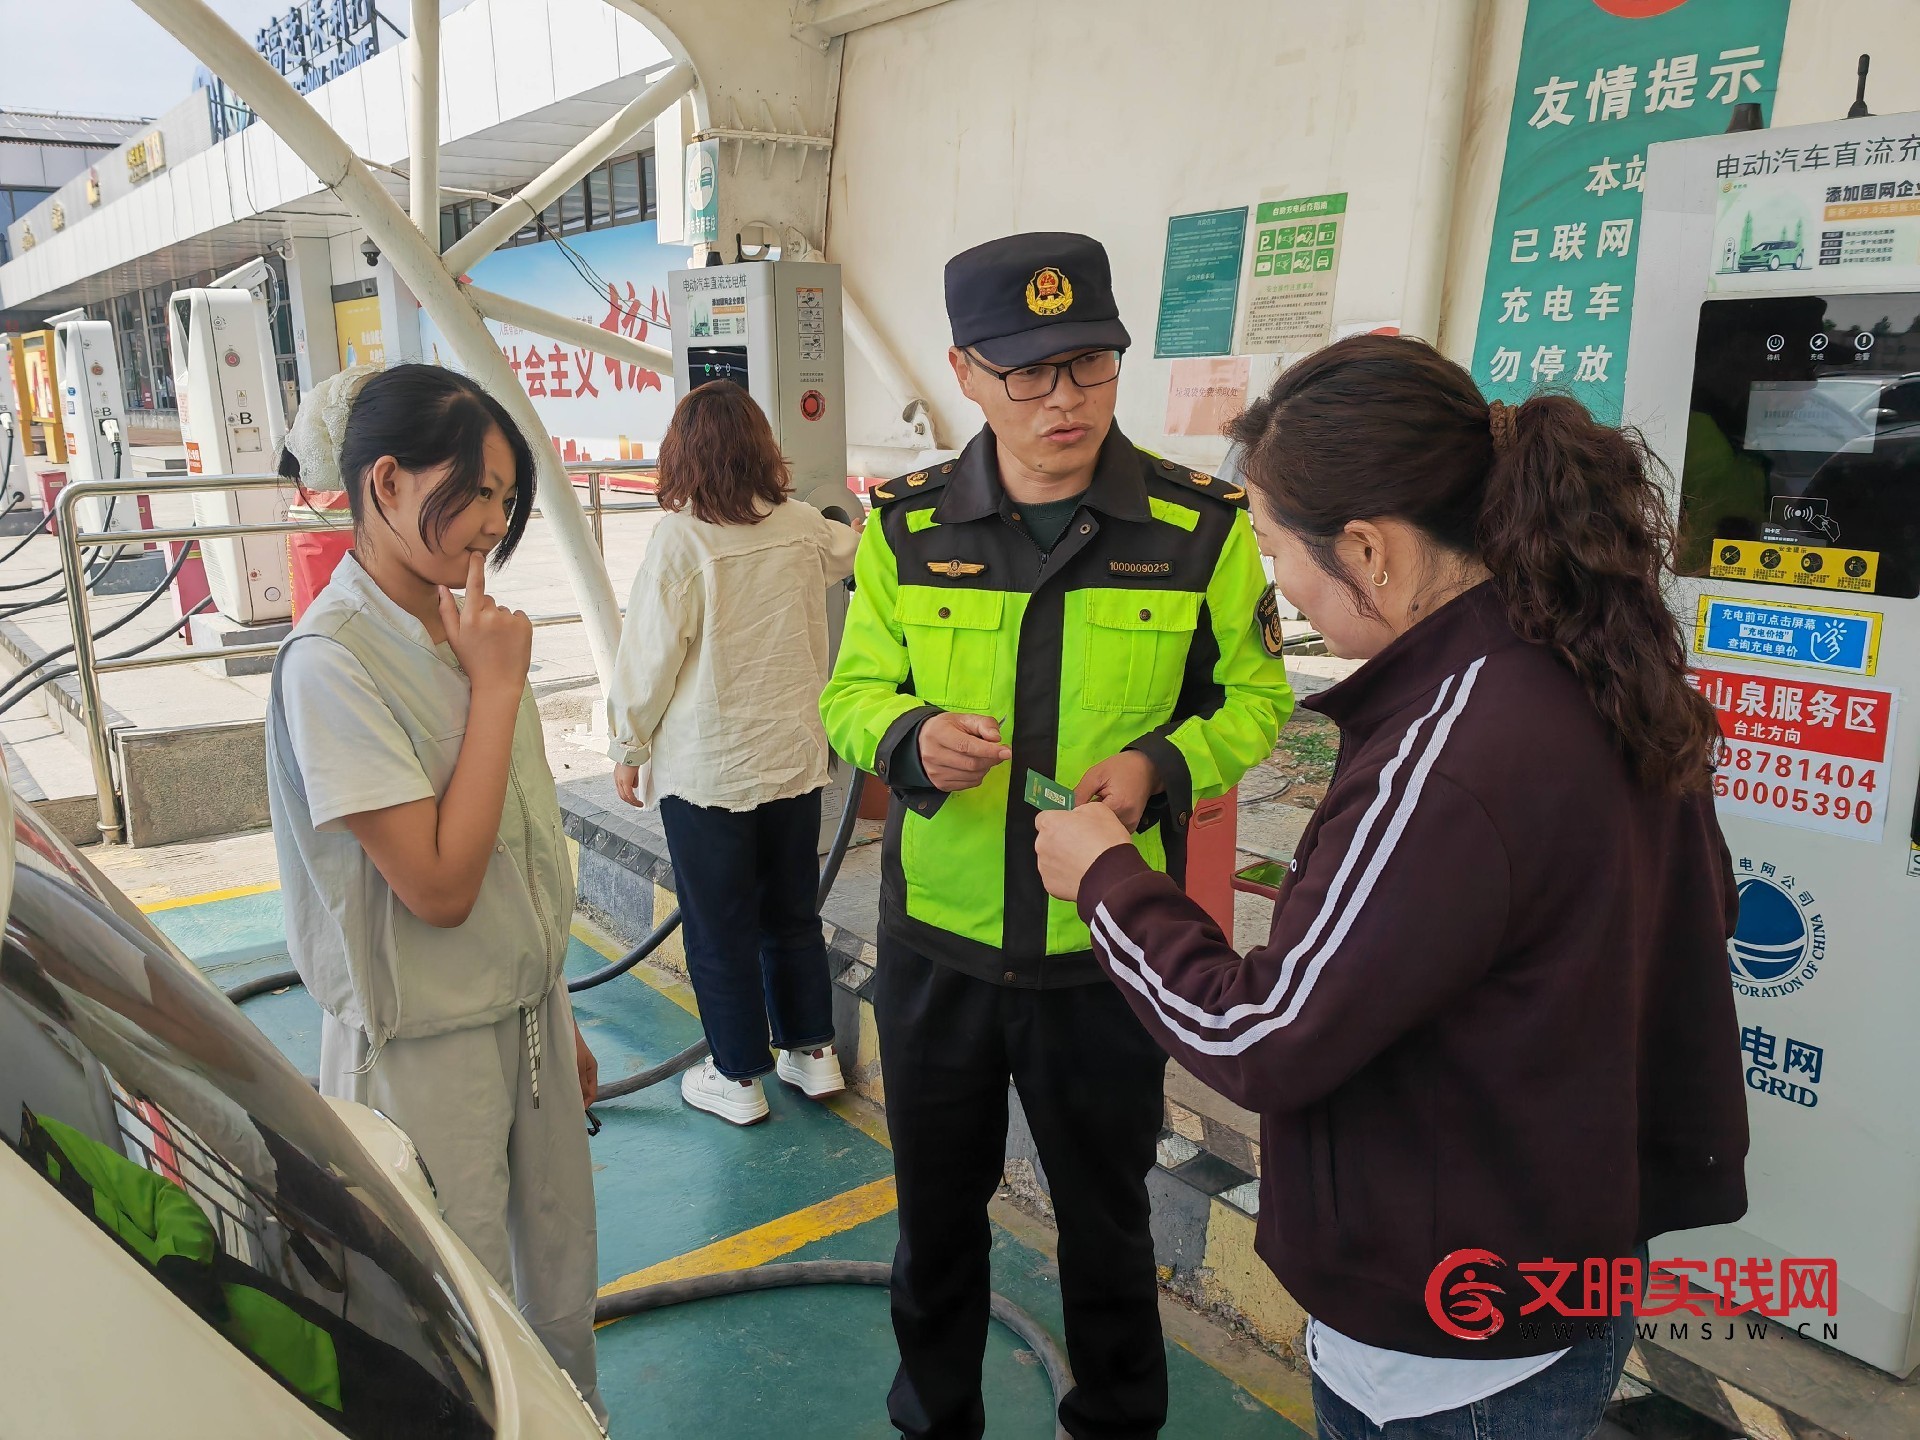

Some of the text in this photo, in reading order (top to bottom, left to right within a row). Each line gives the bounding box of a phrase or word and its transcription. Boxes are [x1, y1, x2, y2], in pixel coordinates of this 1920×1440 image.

[1527, 45, 1765, 129] 友情提示
[1825, 180, 1920, 202] 添加国网企
[1272, 201, 1328, 216] 自助充电操作指南
[1510, 219, 1634, 263] 已联网
[683, 275, 747, 292] 电动汽车直流充电桩
[1498, 282, 1623, 323] 充电车
[1490, 344, 1613, 383] 勿停放
[1766, 352, 1871, 361] 待机 充电 告警
[1175, 387, 1238, 398] 垃圾袋免费领取处
[102, 407, 112, 416] B
[239, 412, 253, 425] B
[1778, 546, 1808, 554] 安全提示
[1109, 561, 1170, 573] 10000090213
[1722, 608, 1817, 631] 充电前可点击屏幕
[1727, 637, 1799, 658] 查询充电单价
[1734, 720, 1801, 744] 台北方向
[1715, 775, 1873, 825] 50005390
[1739, 856, 1815, 907] 电网公司
[1810, 913, 1826, 961] CHINA
[1802, 960, 1820, 980] OF
[1741, 1025, 1824, 1084] 电网
[1745, 1066, 1819, 1108] GRID
